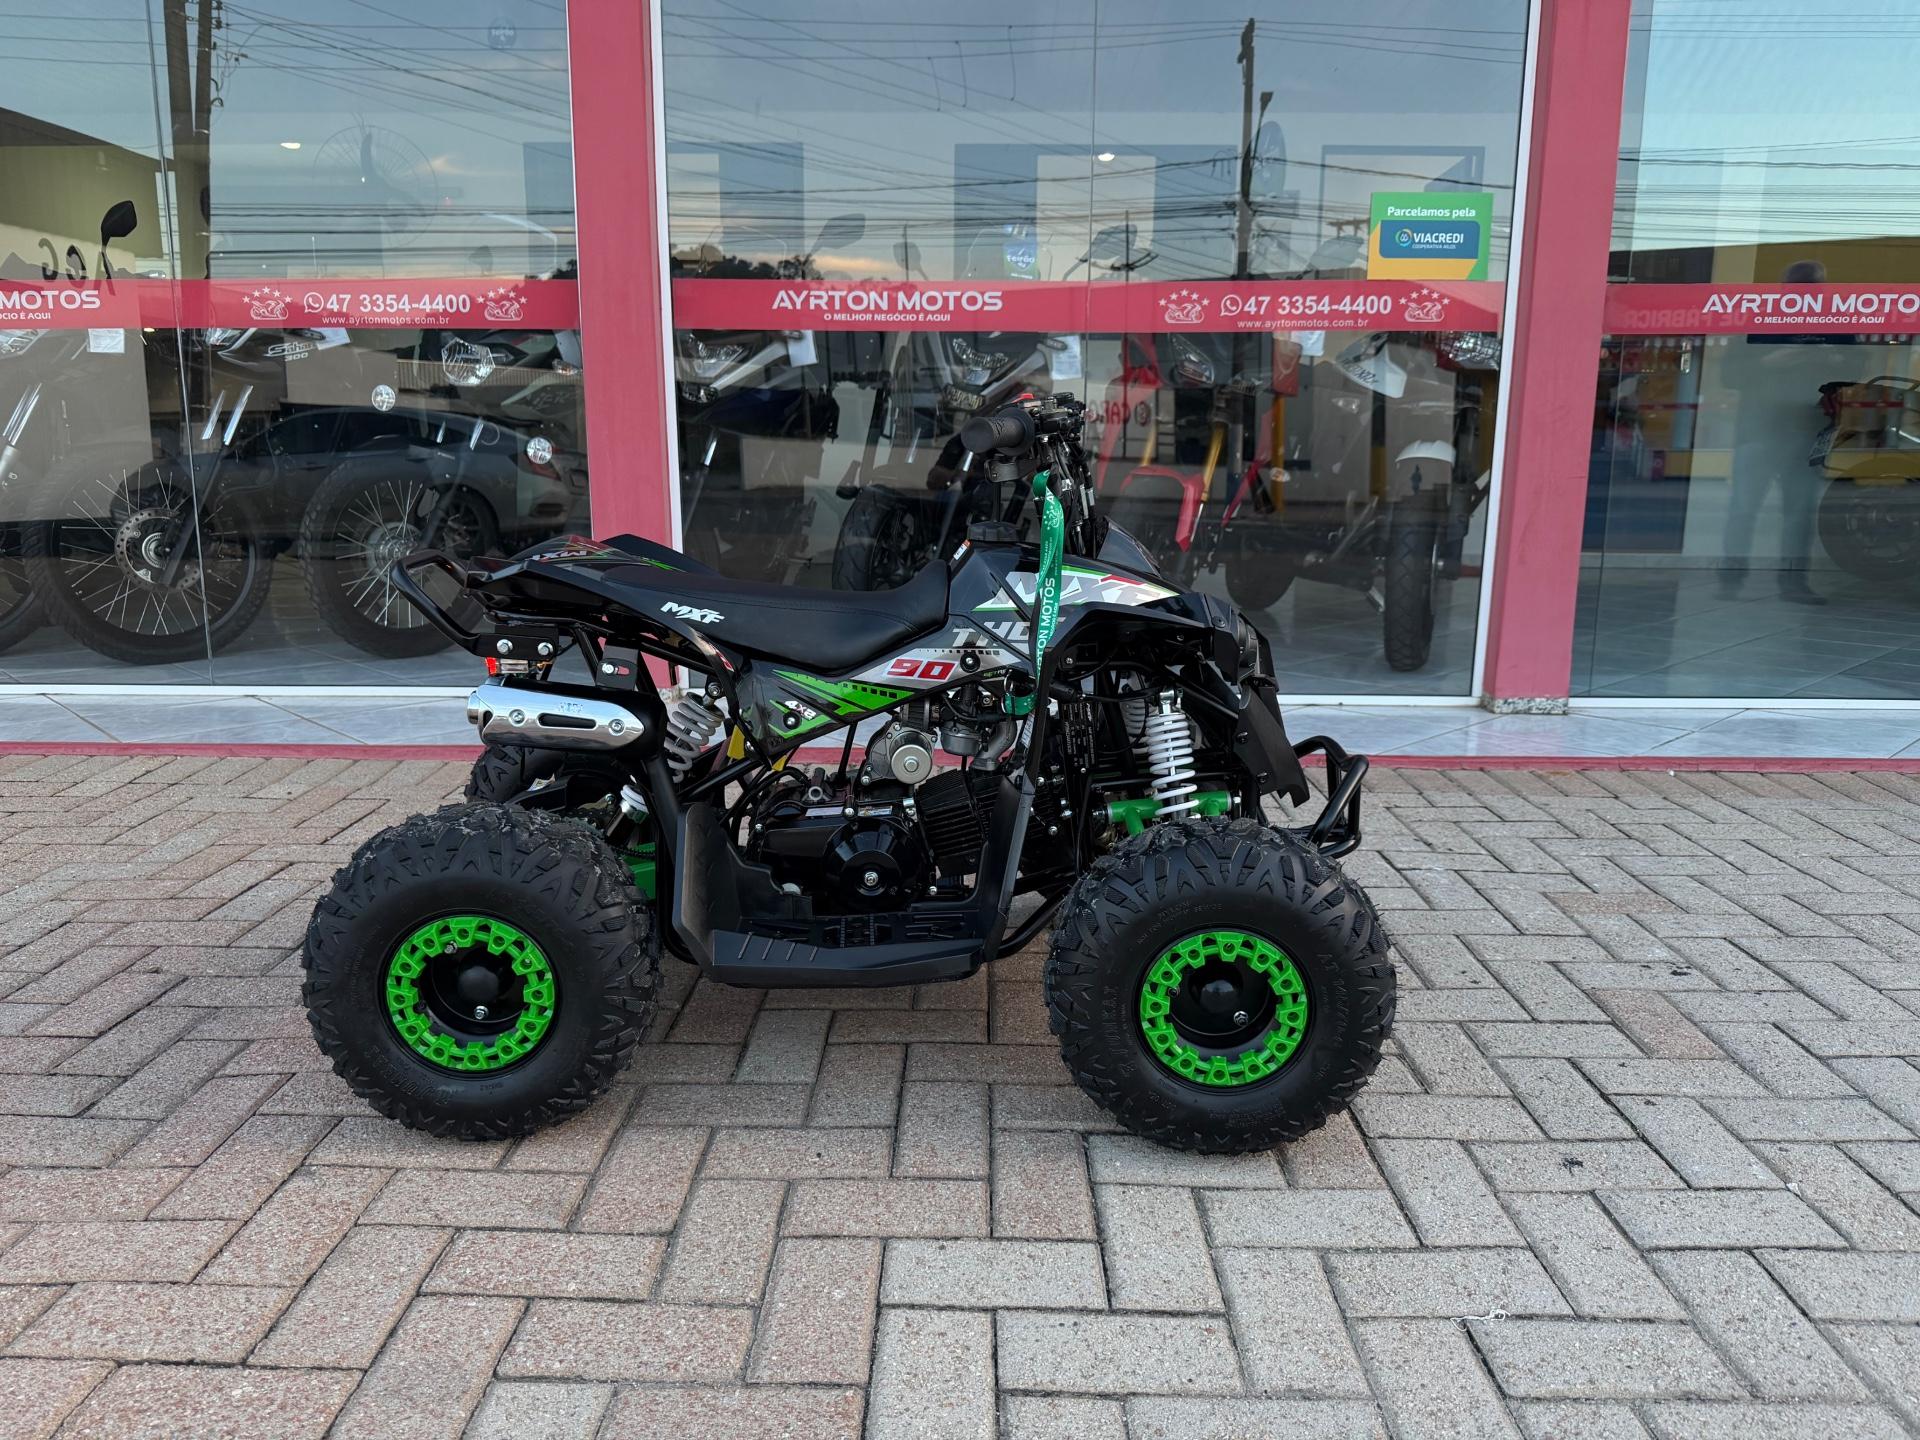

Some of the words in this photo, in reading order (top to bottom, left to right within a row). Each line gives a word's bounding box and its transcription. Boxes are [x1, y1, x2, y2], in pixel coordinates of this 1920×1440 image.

[1387, 206, 1450, 217] Parcelamos
[1452, 208, 1476, 219] pela
[1413, 232, 1464, 244] VIACREDI
[0, 290, 100, 310] MOTOS
[327, 294, 351, 313] 47
[359, 294, 471, 313] 3354-4400
[772, 290, 888, 310] AYRTON
[897, 291, 1003, 311] MOTOS
[1243, 295, 1271, 314] 47
[1277, 295, 1392, 315] 3354-4400
[1702, 293, 1823, 313] AYRTON
[1831, 293, 1920, 313] MOTO
[20, 310, 26, 320] É
[28, 312, 51, 320] AQUI
[322, 315, 450, 326] www.ayrtonmotos.com.br
[824, 313, 831, 321] O
[833, 313, 873, 321] MELHOR
[874, 312, 917, 322] NEGÓCIO
[919, 312, 925, 322] É
[926, 314, 951, 322] AQUI
[1237, 318, 1368, 329] www.ayrtonmotos.com.br
[1754, 316, 1762, 324] O
[1763, 316, 1805, 324] MELHOR
[1805, 315, 1850, 324] NEGÓCIO
[1851, 315, 1858, 324] É
[1859, 316, 1885, 324] AQUI
[1042, 577, 1055, 626] MOTOS
[660, 601, 725, 624] MXF
[886, 657, 956, 681] 90
